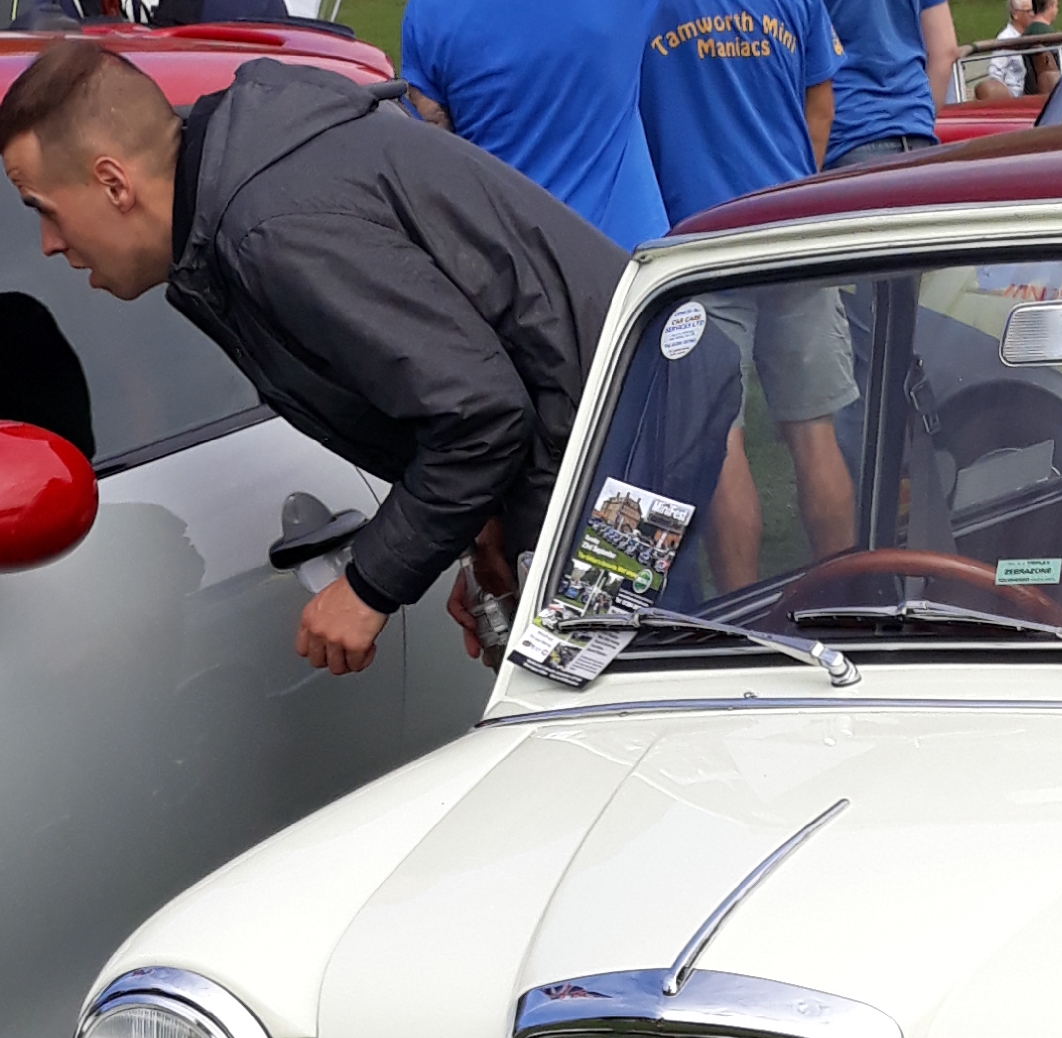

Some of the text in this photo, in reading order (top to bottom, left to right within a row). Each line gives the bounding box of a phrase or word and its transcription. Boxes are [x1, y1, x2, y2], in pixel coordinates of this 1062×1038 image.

[651, 10, 797, 56] Tamworth Mini
[697, 36, 770, 59] Maniacs
